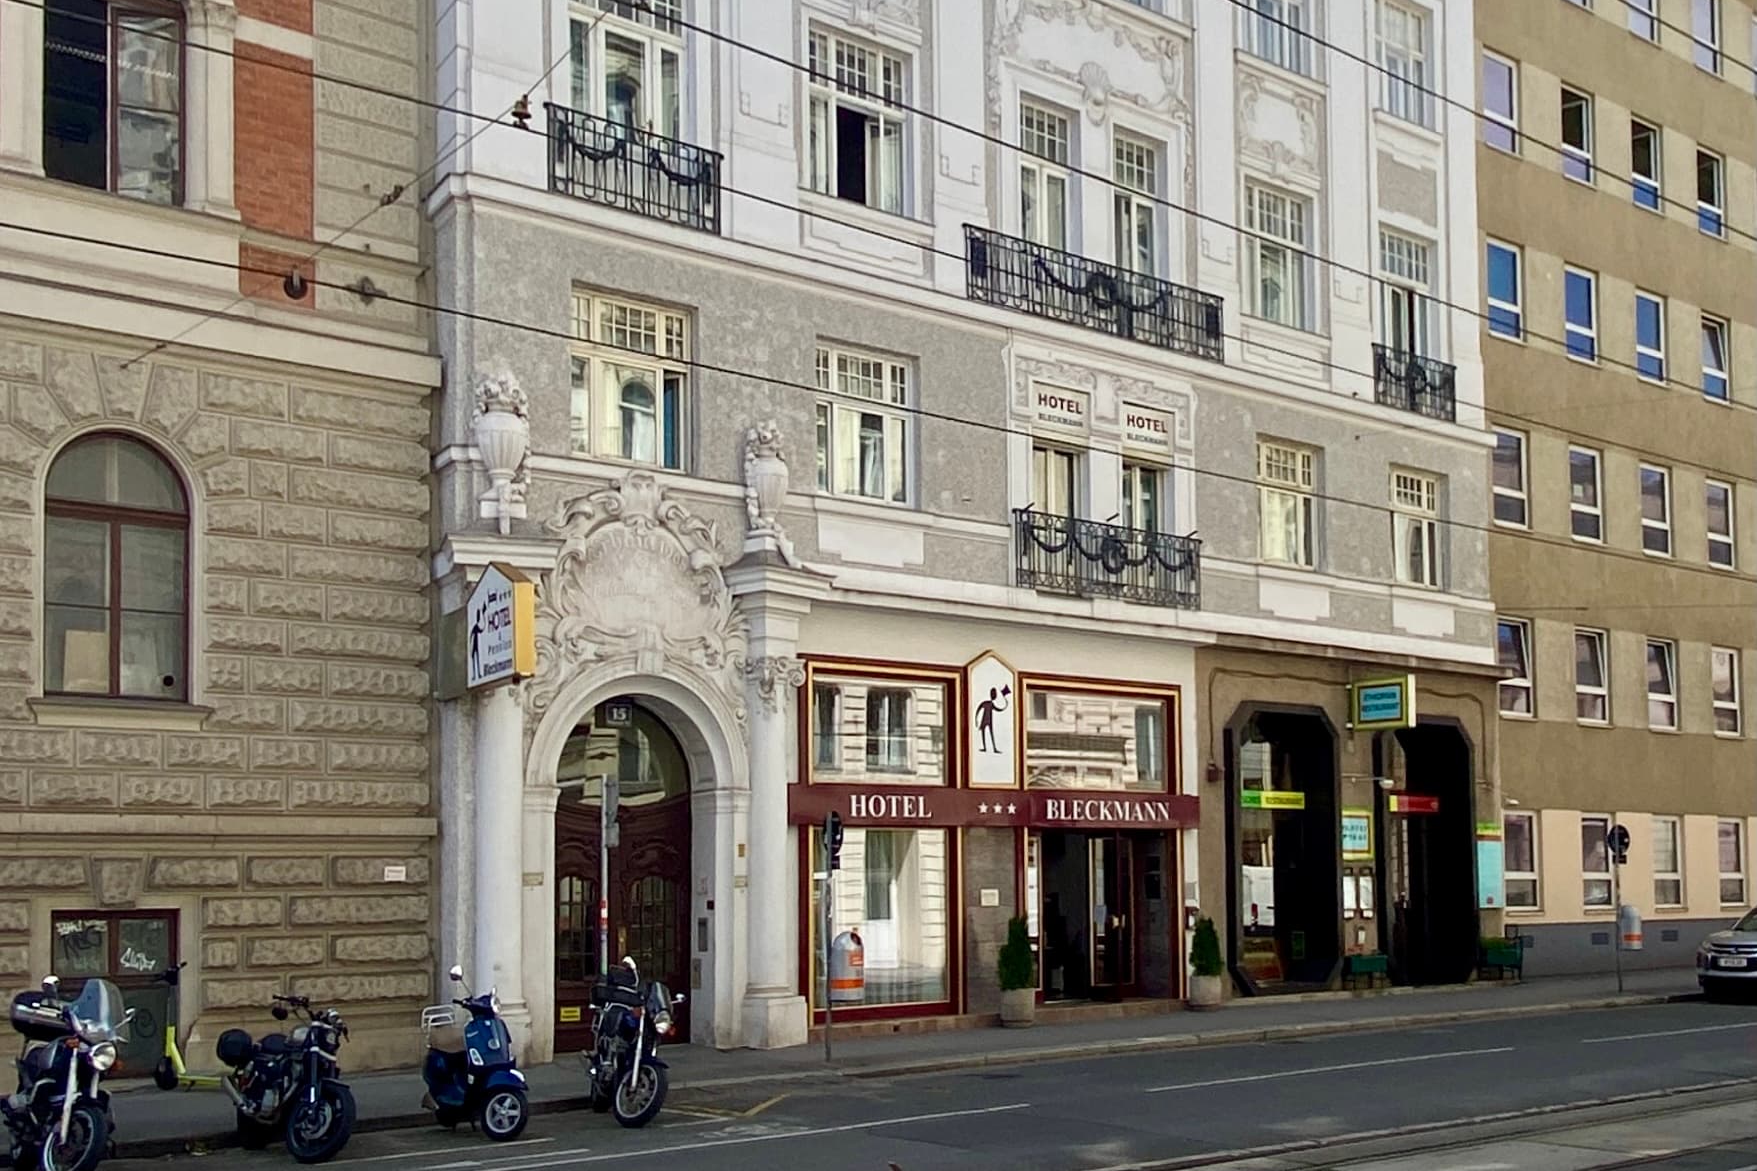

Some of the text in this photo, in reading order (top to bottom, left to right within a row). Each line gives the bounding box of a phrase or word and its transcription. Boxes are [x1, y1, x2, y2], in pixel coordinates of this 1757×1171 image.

[1038, 393, 1083, 415] HOTEL
[1038, 413, 1083, 427] BLECKMANN
[1127, 414, 1168, 433] HOTEL
[488, 607, 511, 633] HOTEL
[612, 707, 627, 721] 15
[850, 794, 1170, 821] HOTEL BLECKMANN
